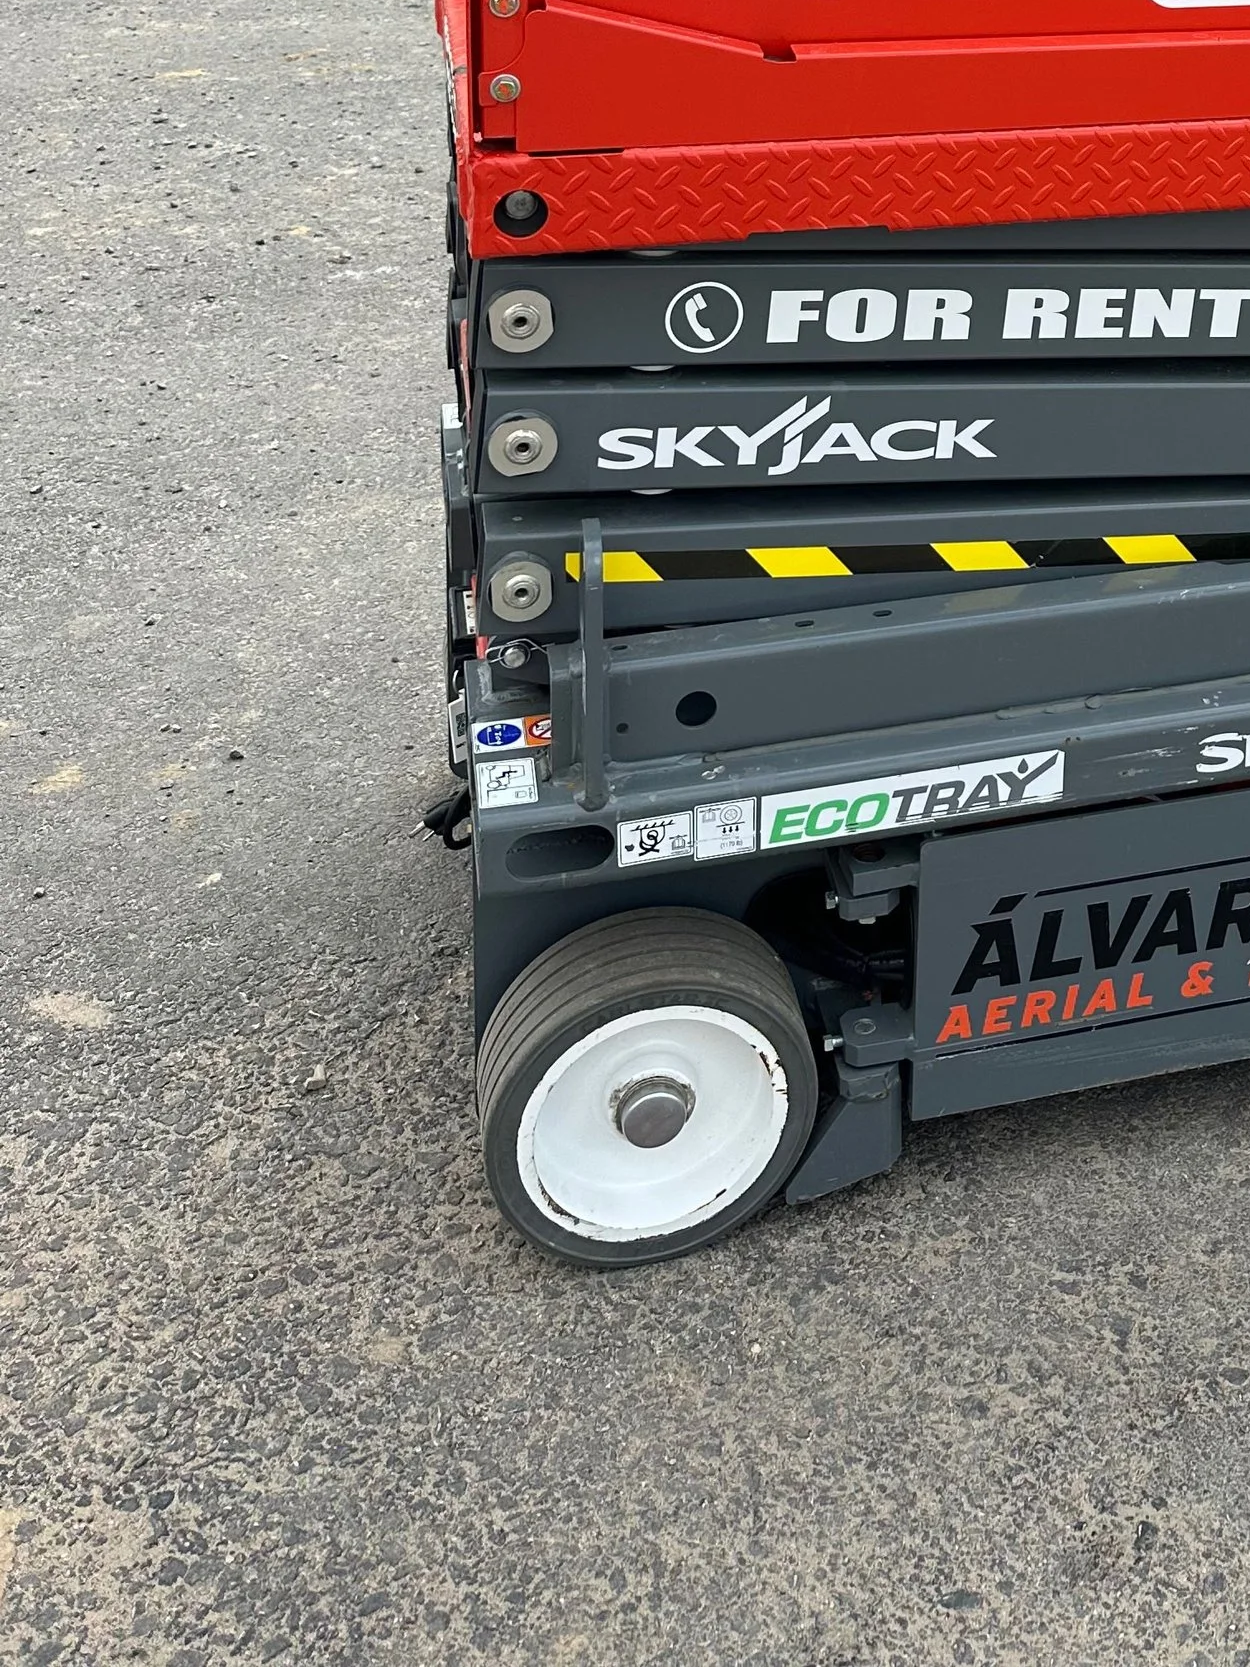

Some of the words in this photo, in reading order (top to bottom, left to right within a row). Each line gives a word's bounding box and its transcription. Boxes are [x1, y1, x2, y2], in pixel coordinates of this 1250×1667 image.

[765, 288, 974, 344] FOR
[597, 395, 998, 476] SKYJACK
[768, 751, 1062, 845] ECOTRAY
[936, 972, 1154, 1044] AERIAL
[1179, 960, 1214, 999] &
